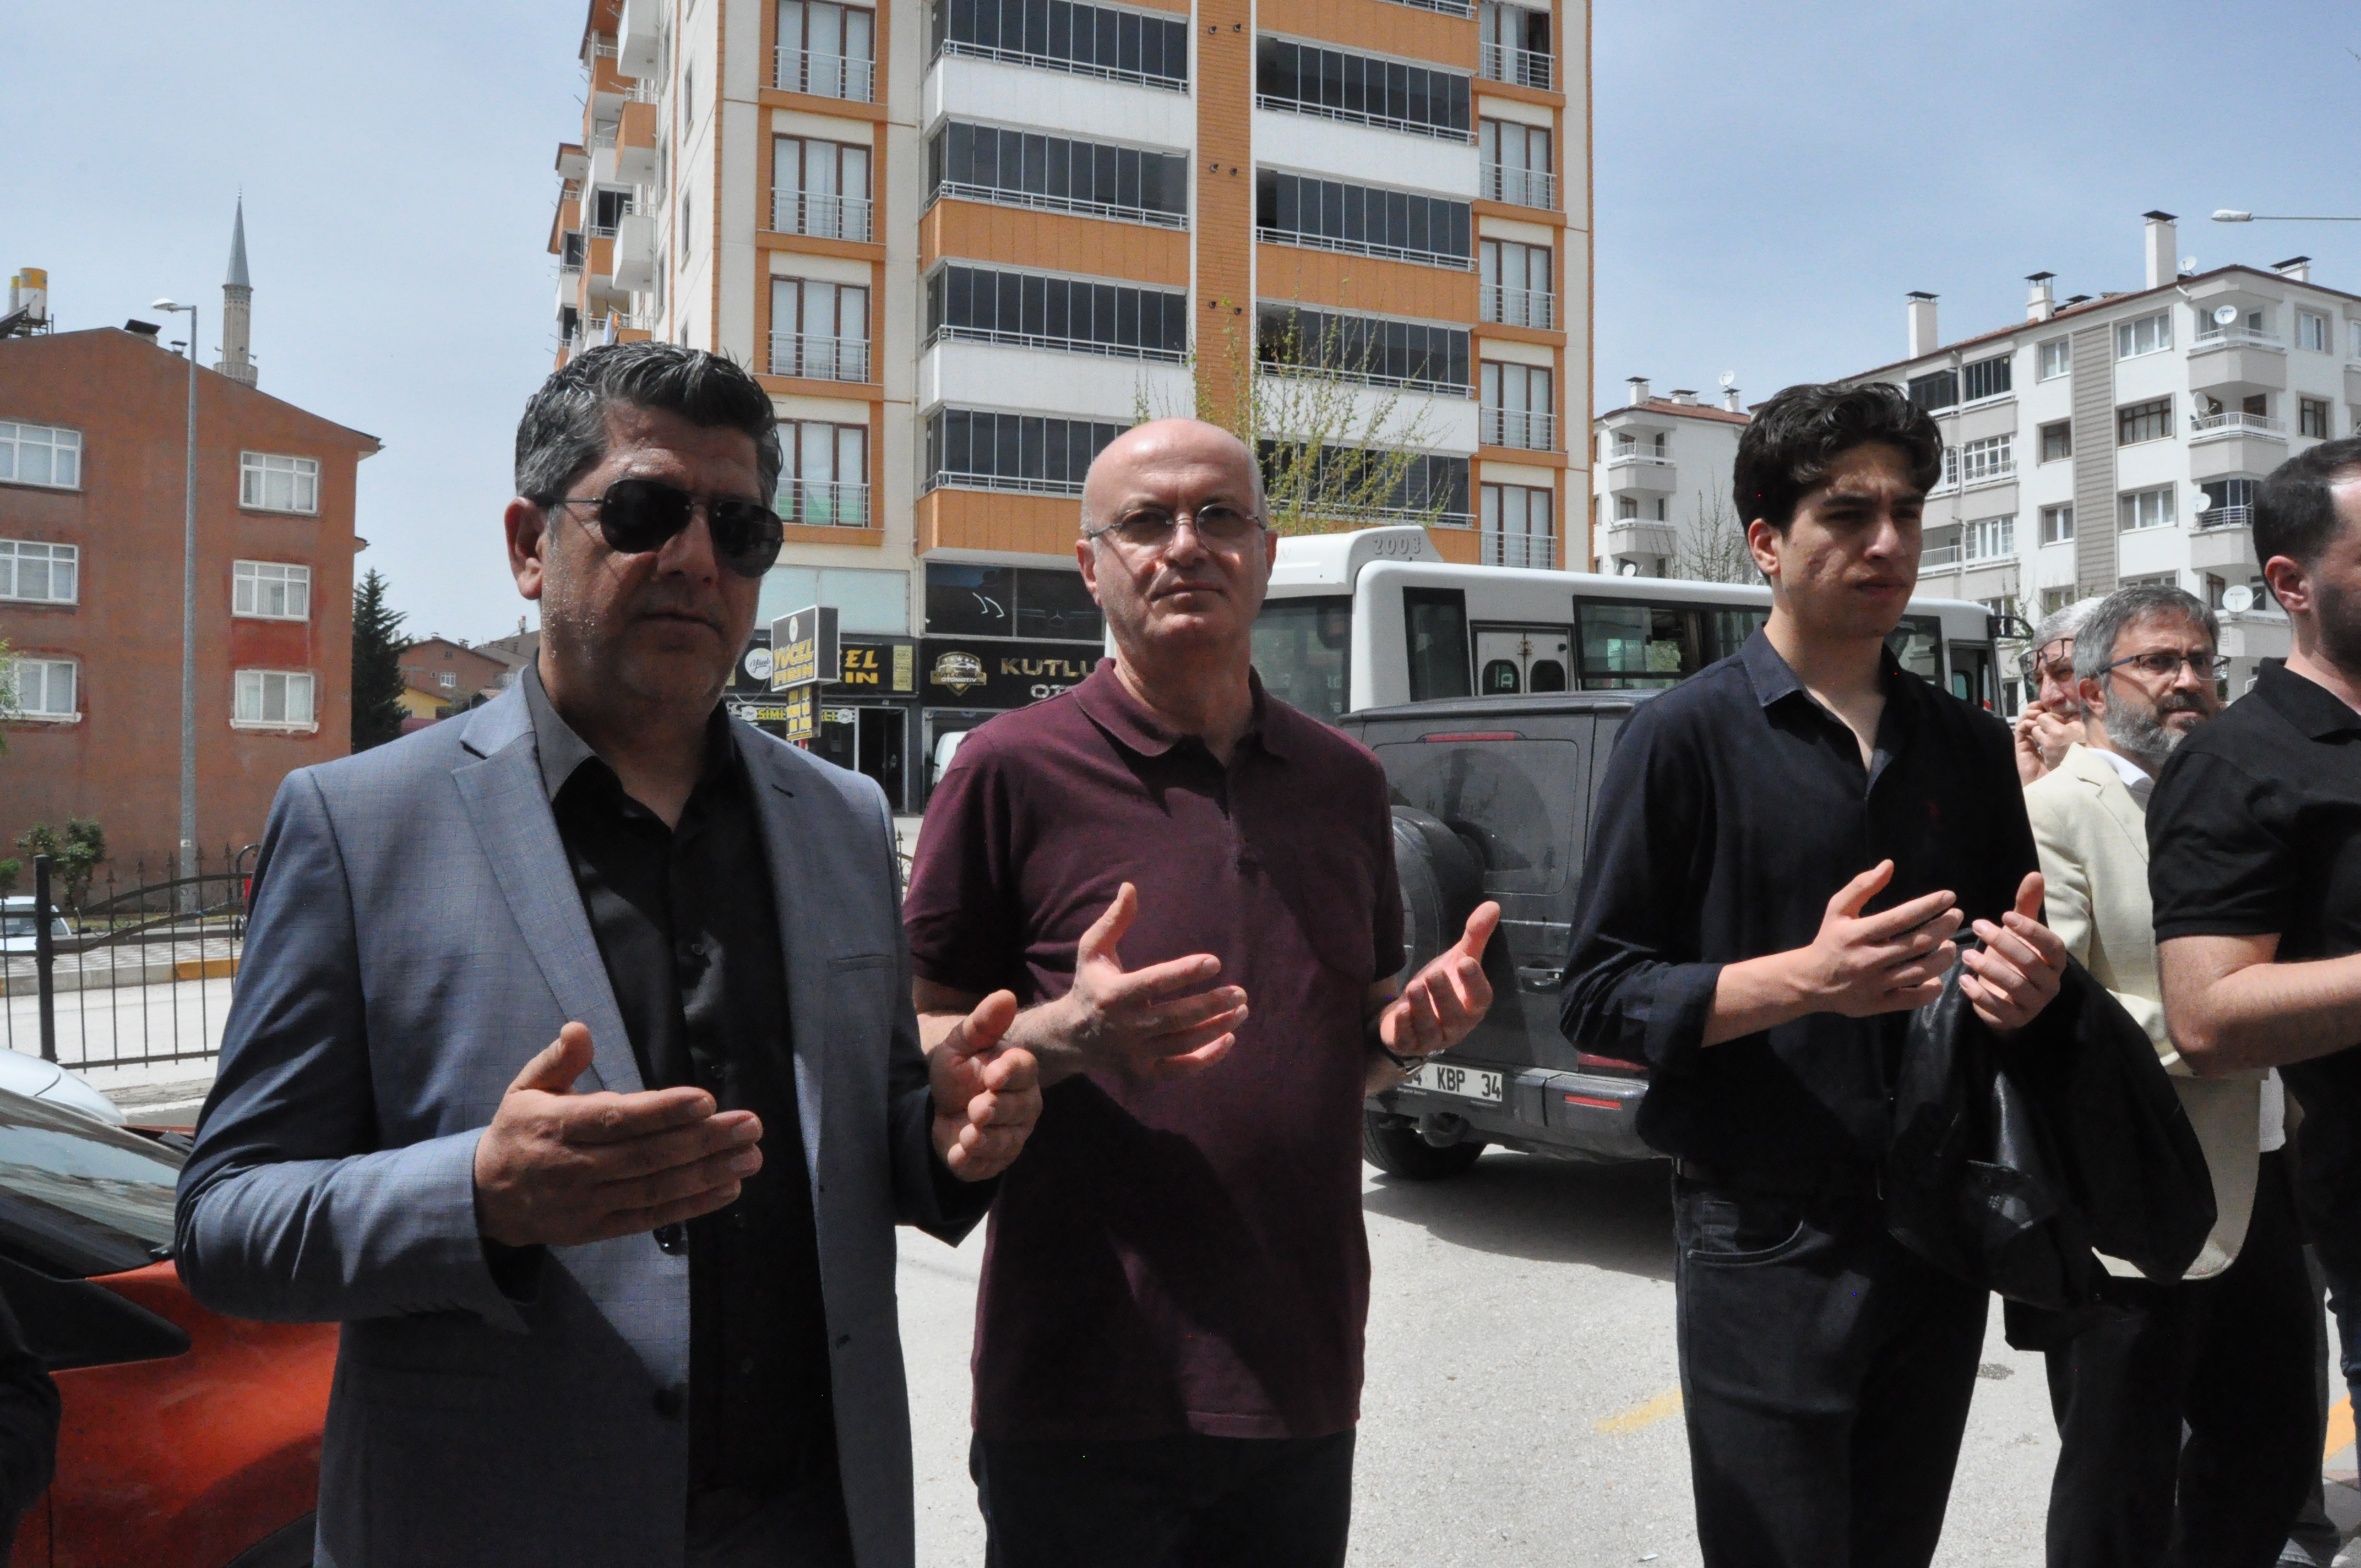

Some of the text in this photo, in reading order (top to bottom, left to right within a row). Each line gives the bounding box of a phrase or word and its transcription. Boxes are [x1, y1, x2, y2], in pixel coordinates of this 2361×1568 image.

[840, 650, 878, 668] EL
[774, 662, 813, 685] FIRIN
[840, 672, 878, 683] IN
[1031, 684, 1073, 698] OT
[758, 706, 786, 720] SİMİ
[1437, 1066, 1465, 1092] KBP
[1481, 1074, 1501, 1099] 34
